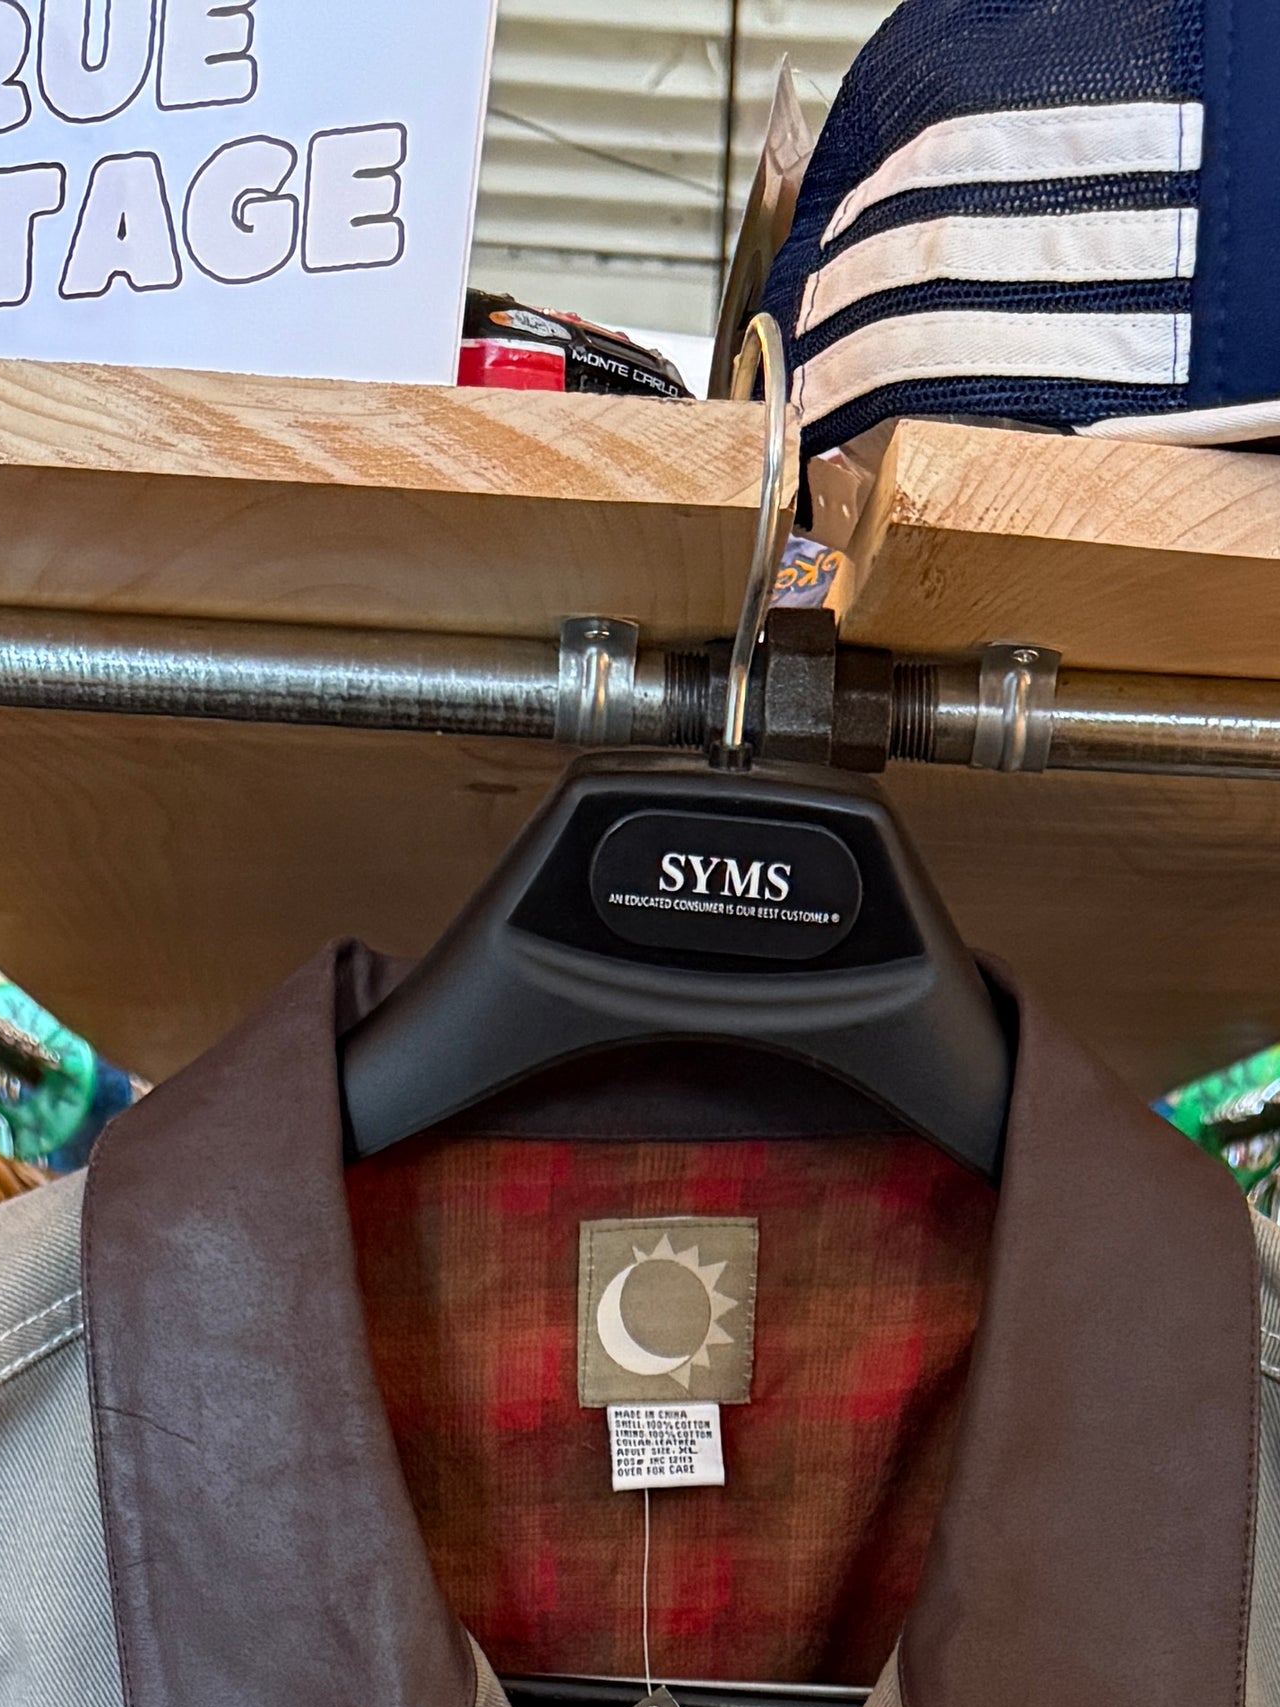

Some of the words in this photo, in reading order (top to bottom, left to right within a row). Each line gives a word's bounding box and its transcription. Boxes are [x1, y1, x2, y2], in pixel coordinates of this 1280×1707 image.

[572, 349, 630, 377] MONTE
[633, 368, 679, 398] CARLO
[659, 852, 792, 902] SYMS
[608, 893, 624, 904] AN
[624, 894, 671, 909] EDUCATED
[673, 898, 725, 915] CONSUMER
[725, 903, 735, 915] IS
[736, 904, 756, 917] OUR
[757, 907, 779, 920] BEST
[780, 909, 830, 924] CUSTOMER
[614, 1410, 640, 1419] MADE
[658, 1410, 687, 1419] CHINA
[616, 1448, 646, 1457] ADULT
[679, 1446, 698, 1454] XL
[617, 1467, 642, 1477] OVER
[646, 1466, 665, 1475] FOR
[669, 1464, 695, 1475] CARE
